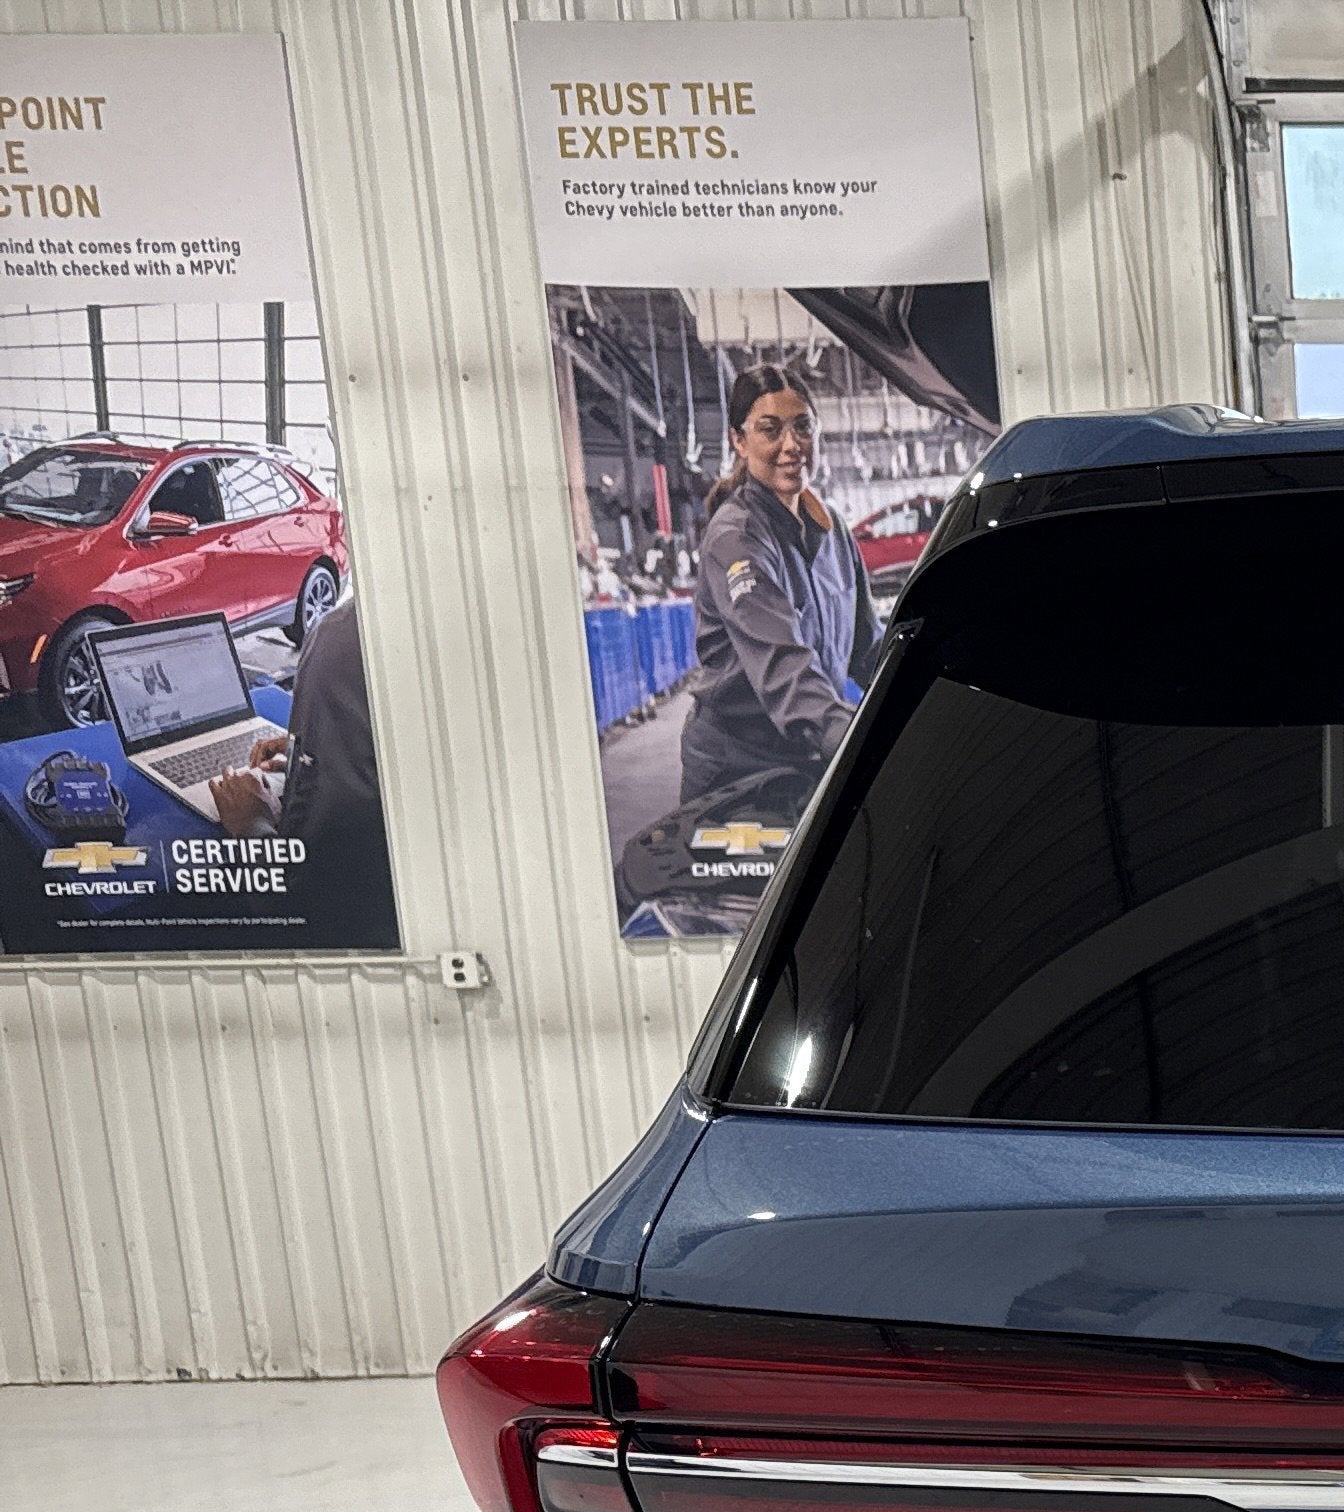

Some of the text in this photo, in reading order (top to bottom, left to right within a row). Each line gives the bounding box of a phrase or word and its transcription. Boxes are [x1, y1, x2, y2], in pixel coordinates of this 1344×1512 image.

[550, 81, 756, 116] TRUST THE
[557, 125, 740, 160] EXPERTS.
[0, 140, 29, 174] E
[562, 178, 878, 199] Factory trained technicians know your
[565, 201, 844, 220] Chevy vehicle better than anyone.
[39, 238, 75, 254] that
[78, 241, 132, 254] comes
[136, 237, 177, 254] from
[181, 236, 241, 257] getting
[4, 259, 58, 277] health
[62, 259, 130, 276] checked
[134, 259, 172, 276] with
[176, 262, 186, 275] a
[172, 837, 307, 865] CERTIFIED
[44, 879, 157, 898] CHEVROLET
[175, 866, 288, 894] SERVICE
